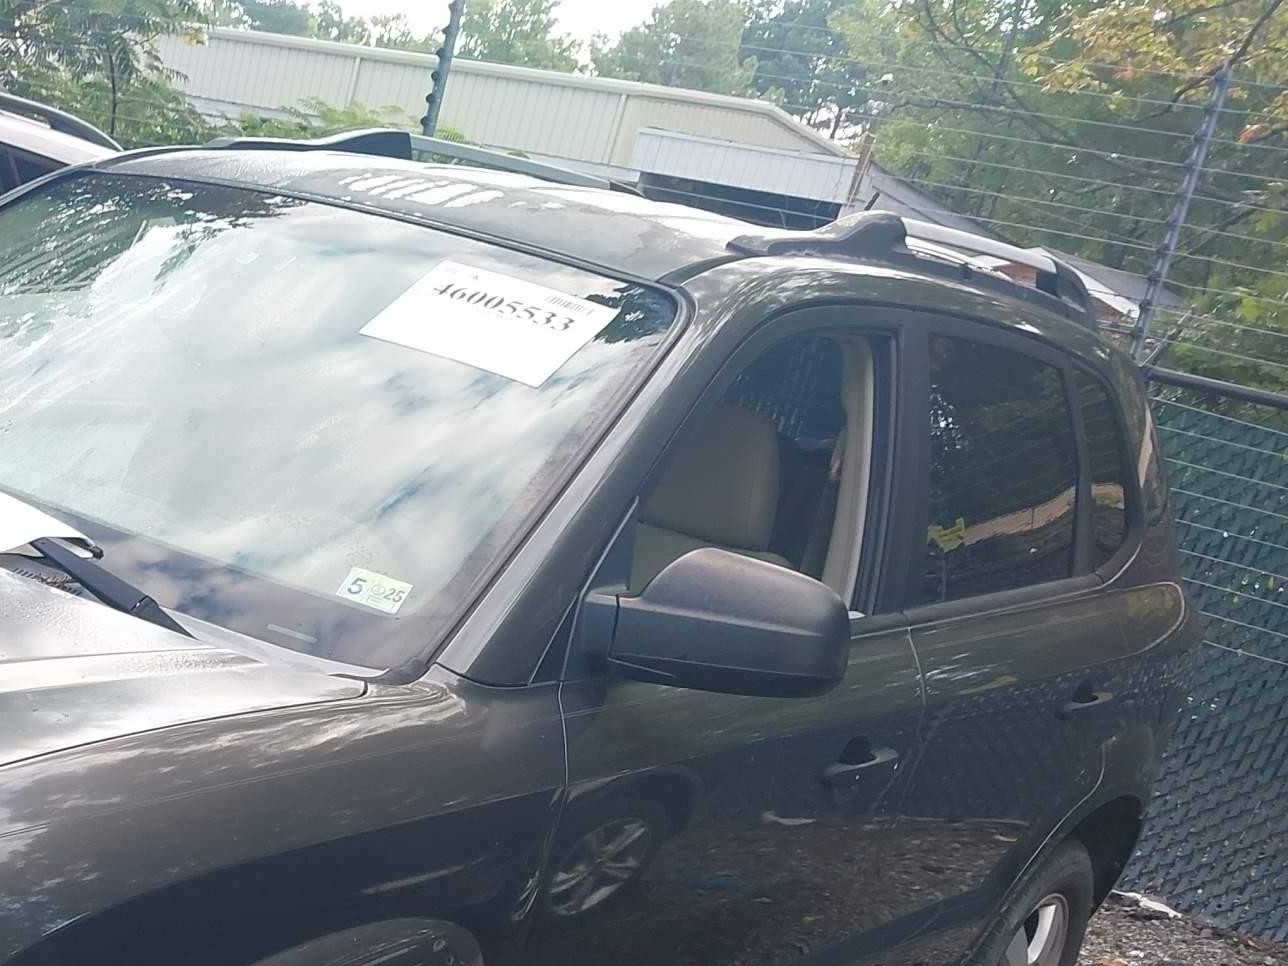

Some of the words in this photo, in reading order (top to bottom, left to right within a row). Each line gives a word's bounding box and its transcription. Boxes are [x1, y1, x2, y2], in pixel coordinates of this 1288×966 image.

[433, 283, 575, 331] 46005533
[347, 577, 367, 595] 5
[383, 588, 405, 603] 25
